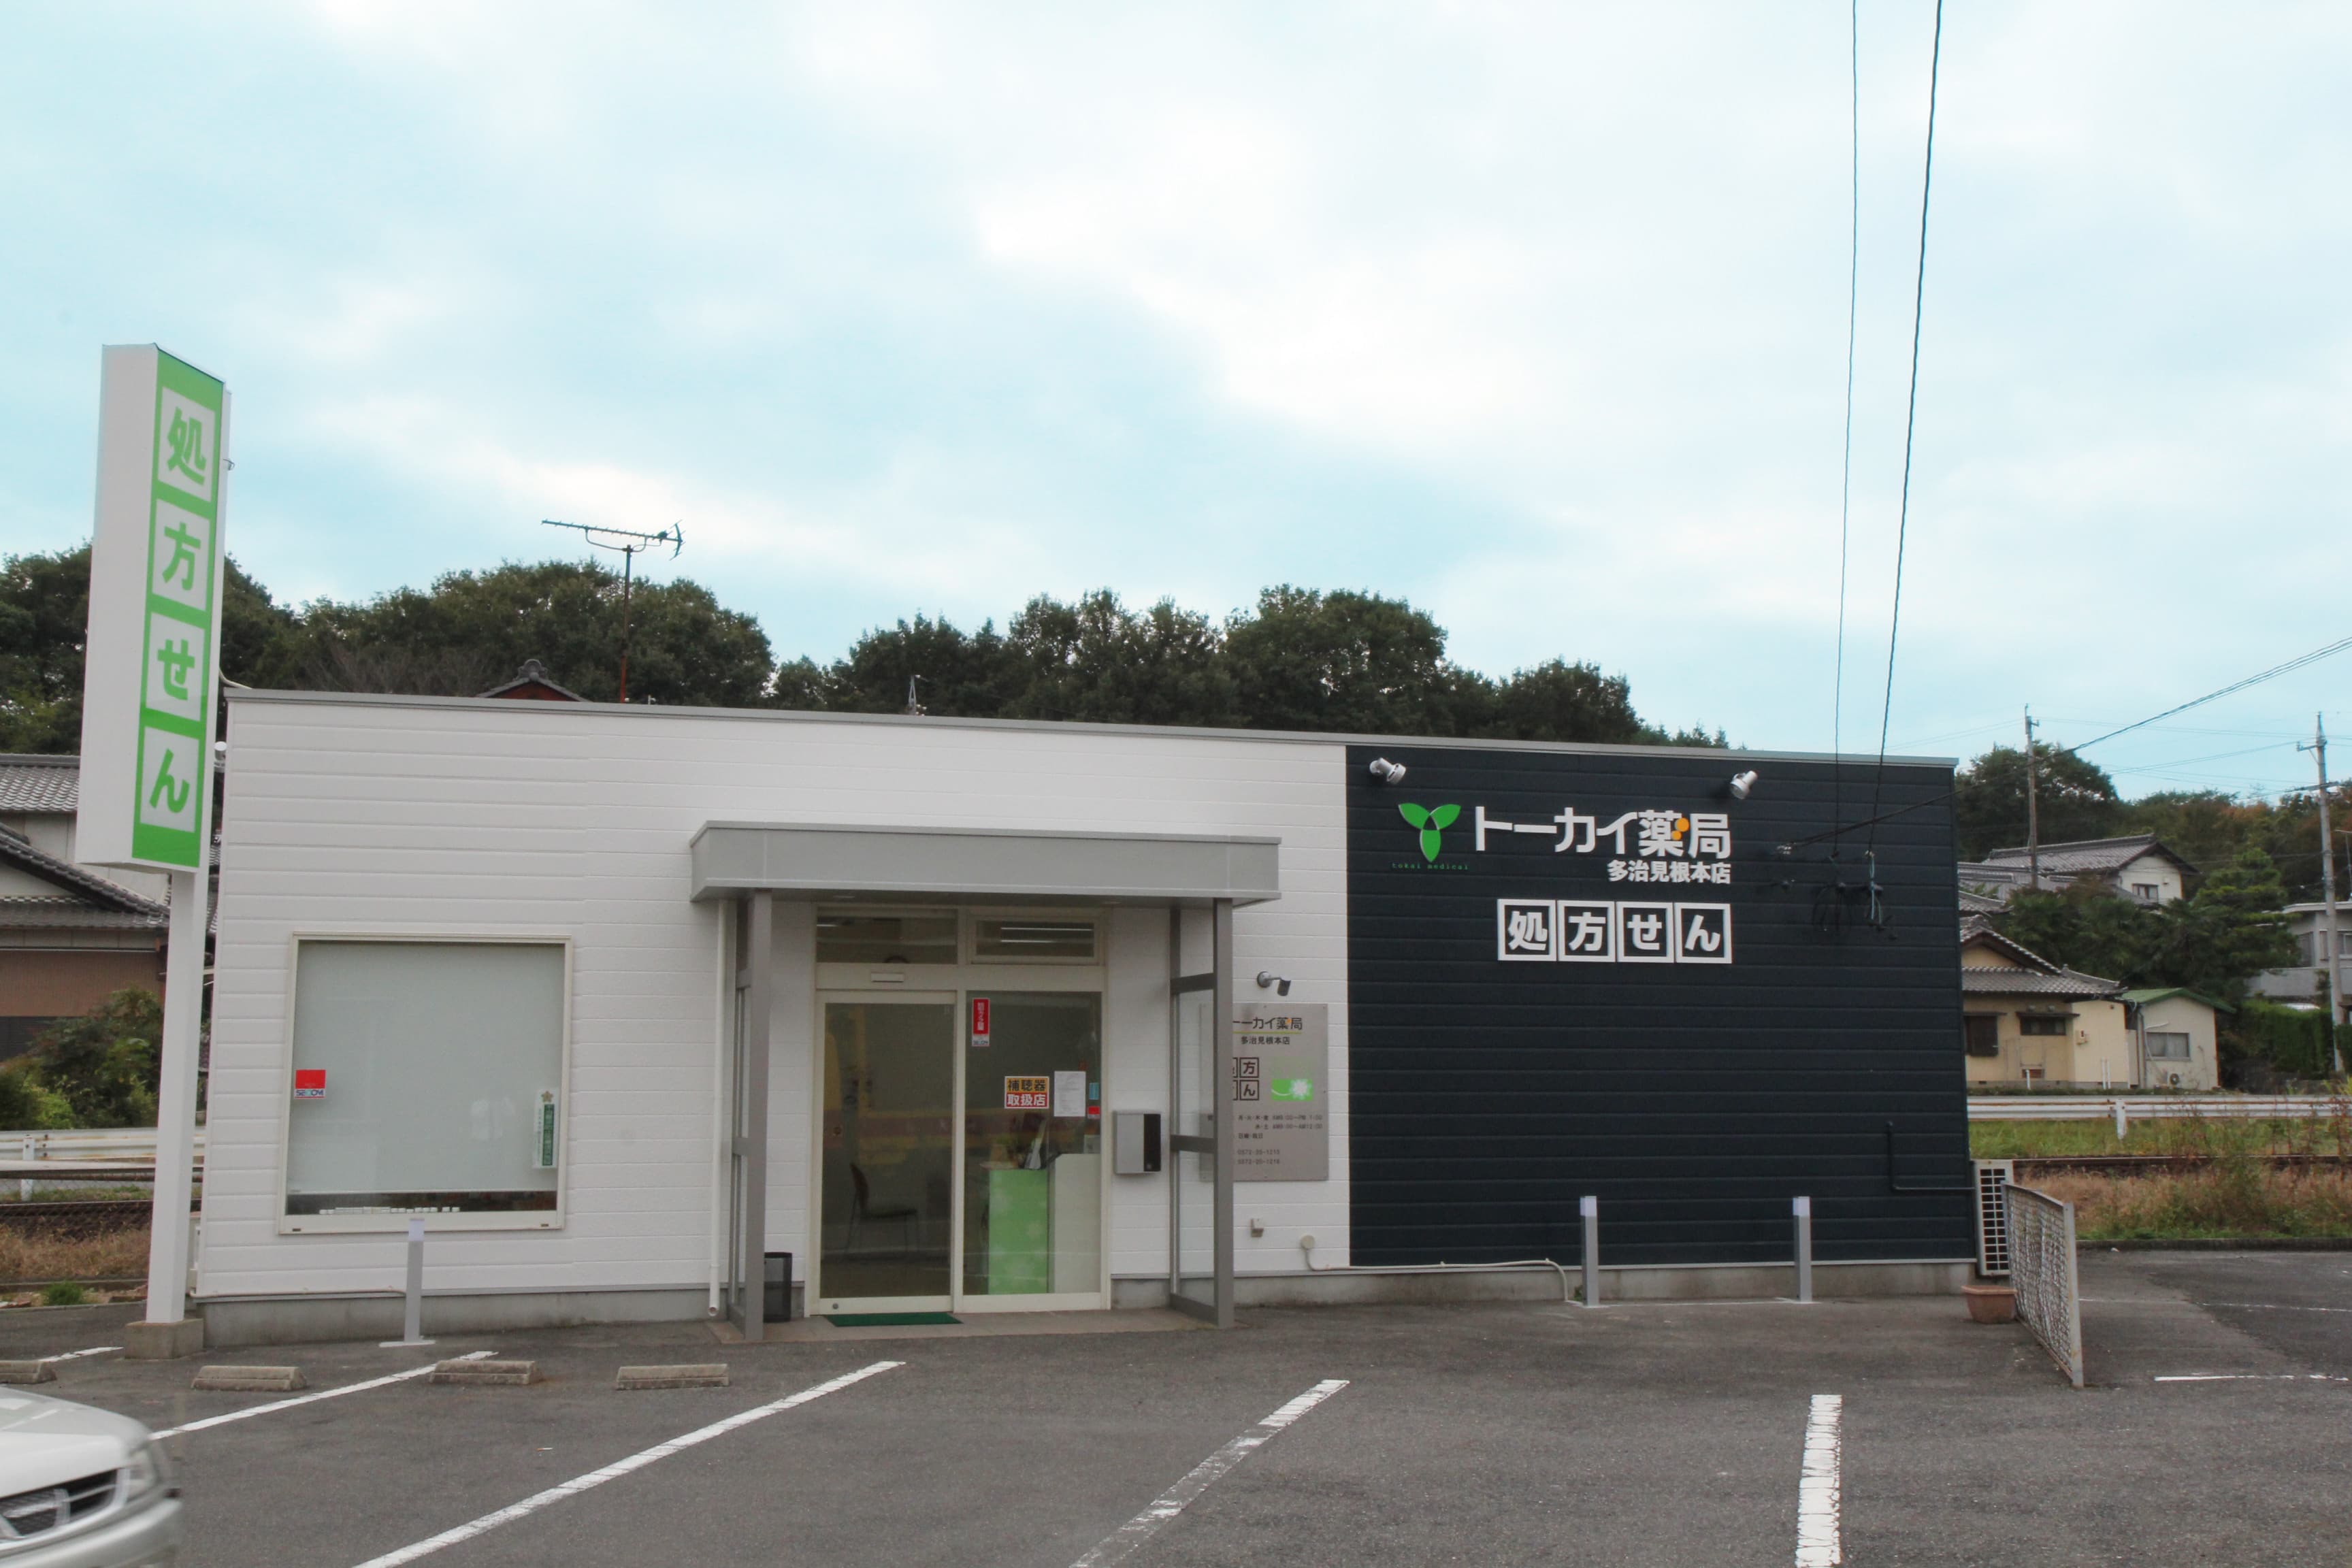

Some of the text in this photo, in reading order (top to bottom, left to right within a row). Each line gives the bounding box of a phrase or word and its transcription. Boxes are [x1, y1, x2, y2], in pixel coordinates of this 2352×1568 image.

[149, 406, 207, 813] 処方せん
[1475, 806, 1731, 859] トーカイ薬局
[1607, 860, 1731, 884] 多治見根本店
[1507, 911, 1720, 952] 処方せん
[1007, 1094, 1046, 1107] 取扱店
[1008, 1079, 1046, 1092] 補聴器
